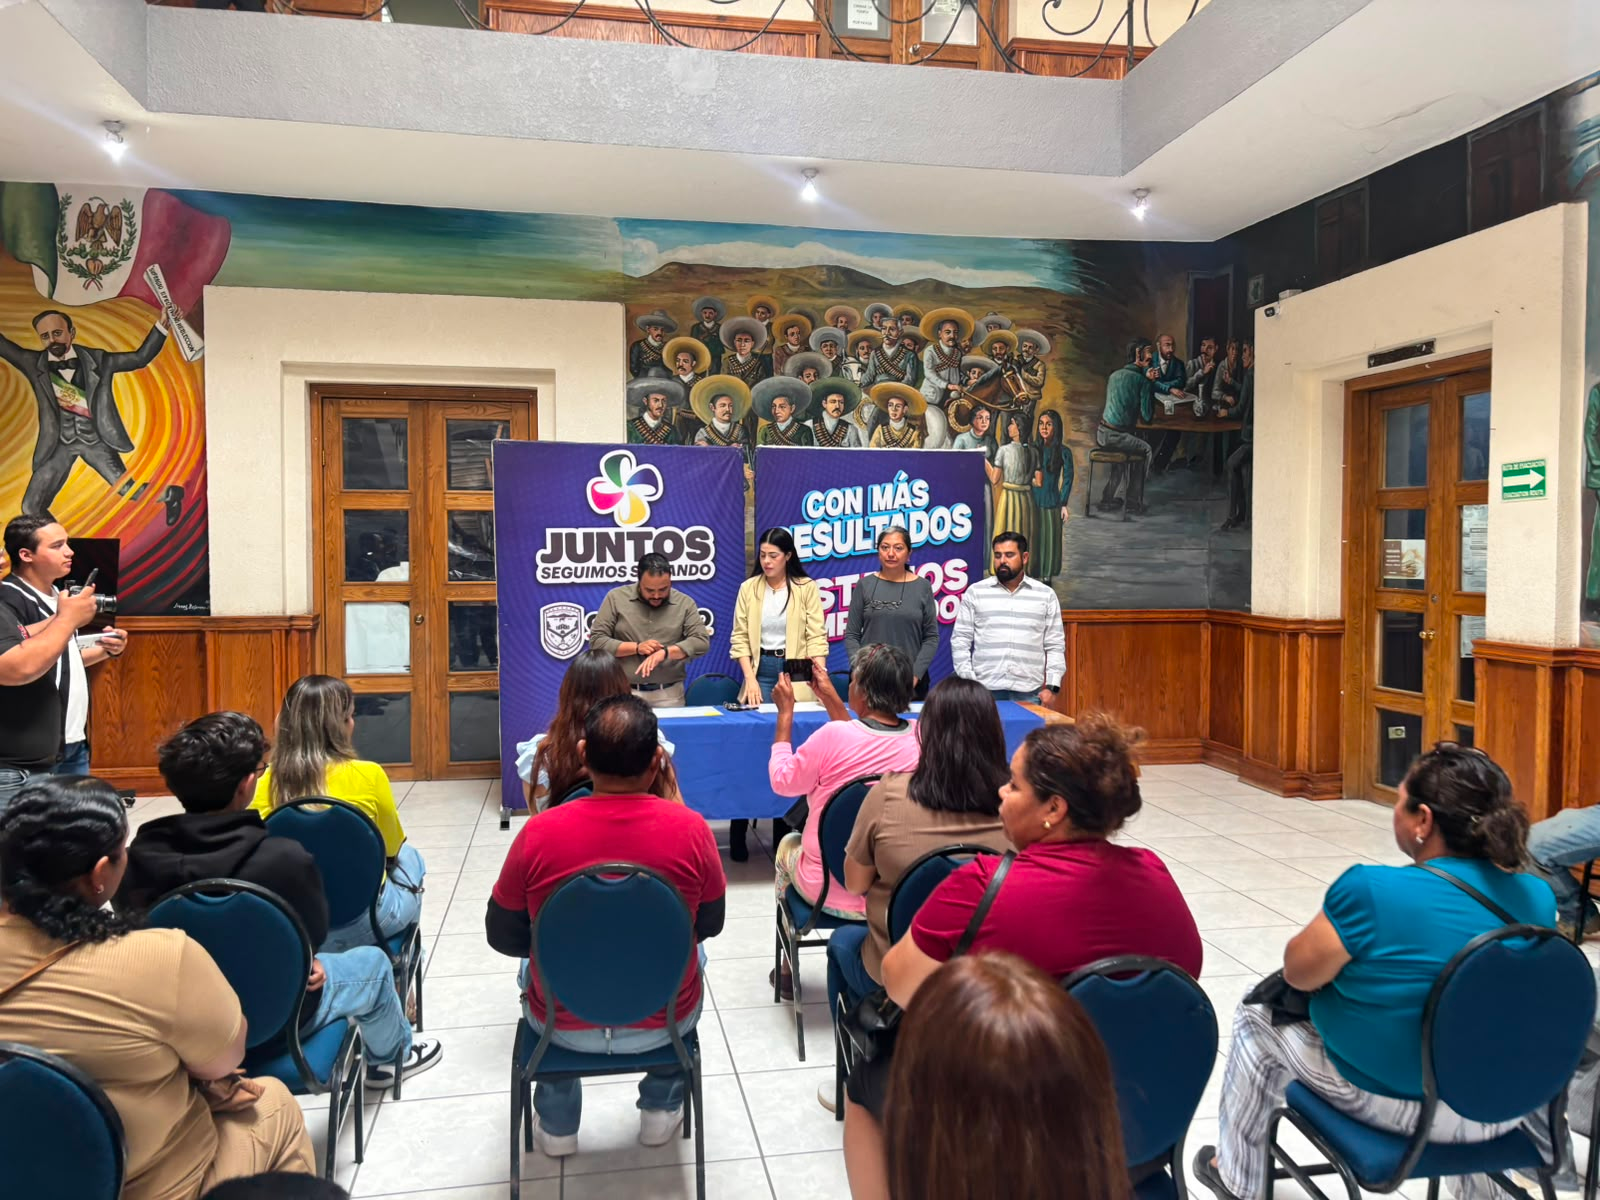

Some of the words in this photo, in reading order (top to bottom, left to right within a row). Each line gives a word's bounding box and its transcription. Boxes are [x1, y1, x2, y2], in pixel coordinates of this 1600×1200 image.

[804, 487, 863, 519] CON
[870, 471, 930, 512] MÁS
[540, 530, 711, 564] JUNTOS
[784, 504, 973, 560] ESULTDOS
[541, 565, 628, 579] SEGUIMOS
[630, 563, 712, 578] SANDO
[818, 558, 969, 611] STOS
